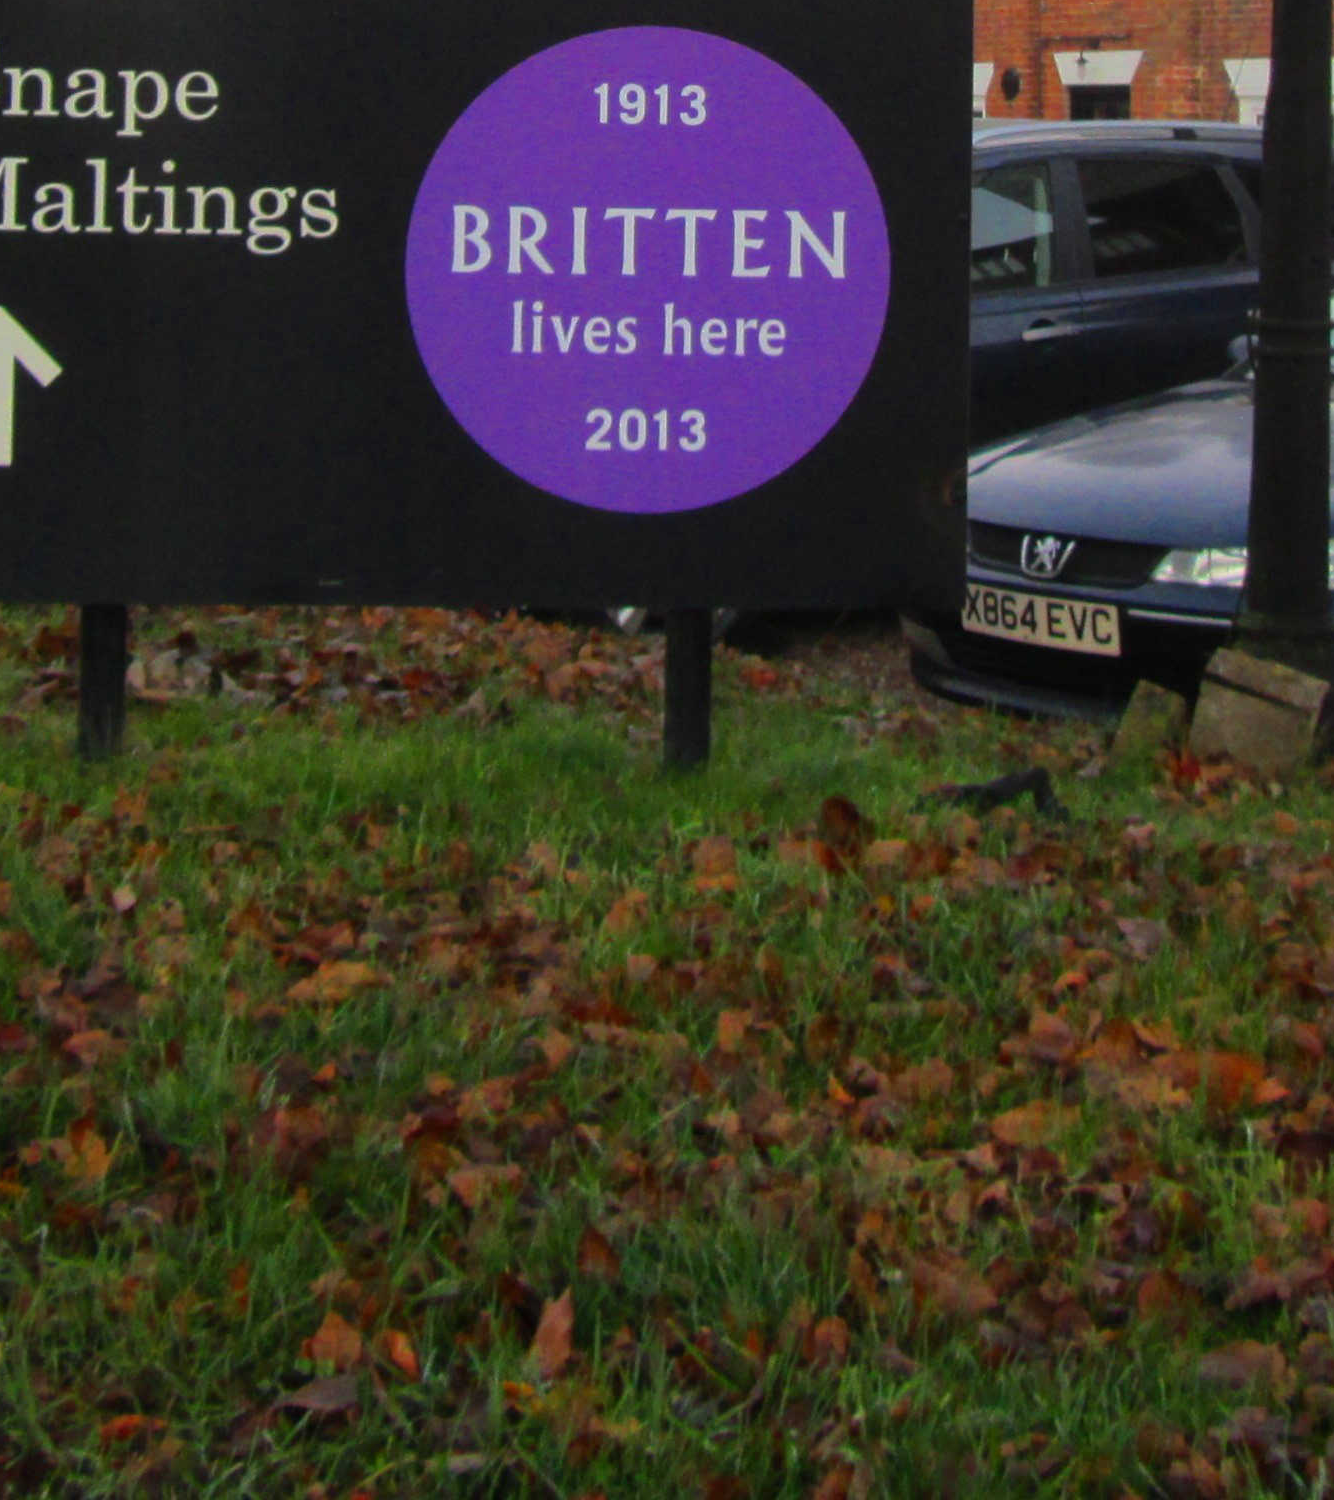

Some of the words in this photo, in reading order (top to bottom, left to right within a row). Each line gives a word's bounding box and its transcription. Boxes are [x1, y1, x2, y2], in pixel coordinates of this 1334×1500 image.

[593, 82, 707, 126] 1913
[451, 204, 847, 279] BRITTEN
[510, 300, 638, 355] lives
[662, 302, 787, 357] here
[585, 407, 707, 452] 2013
[966, 588, 1038, 634] X864
[1046, 601, 1113, 645] EVC
